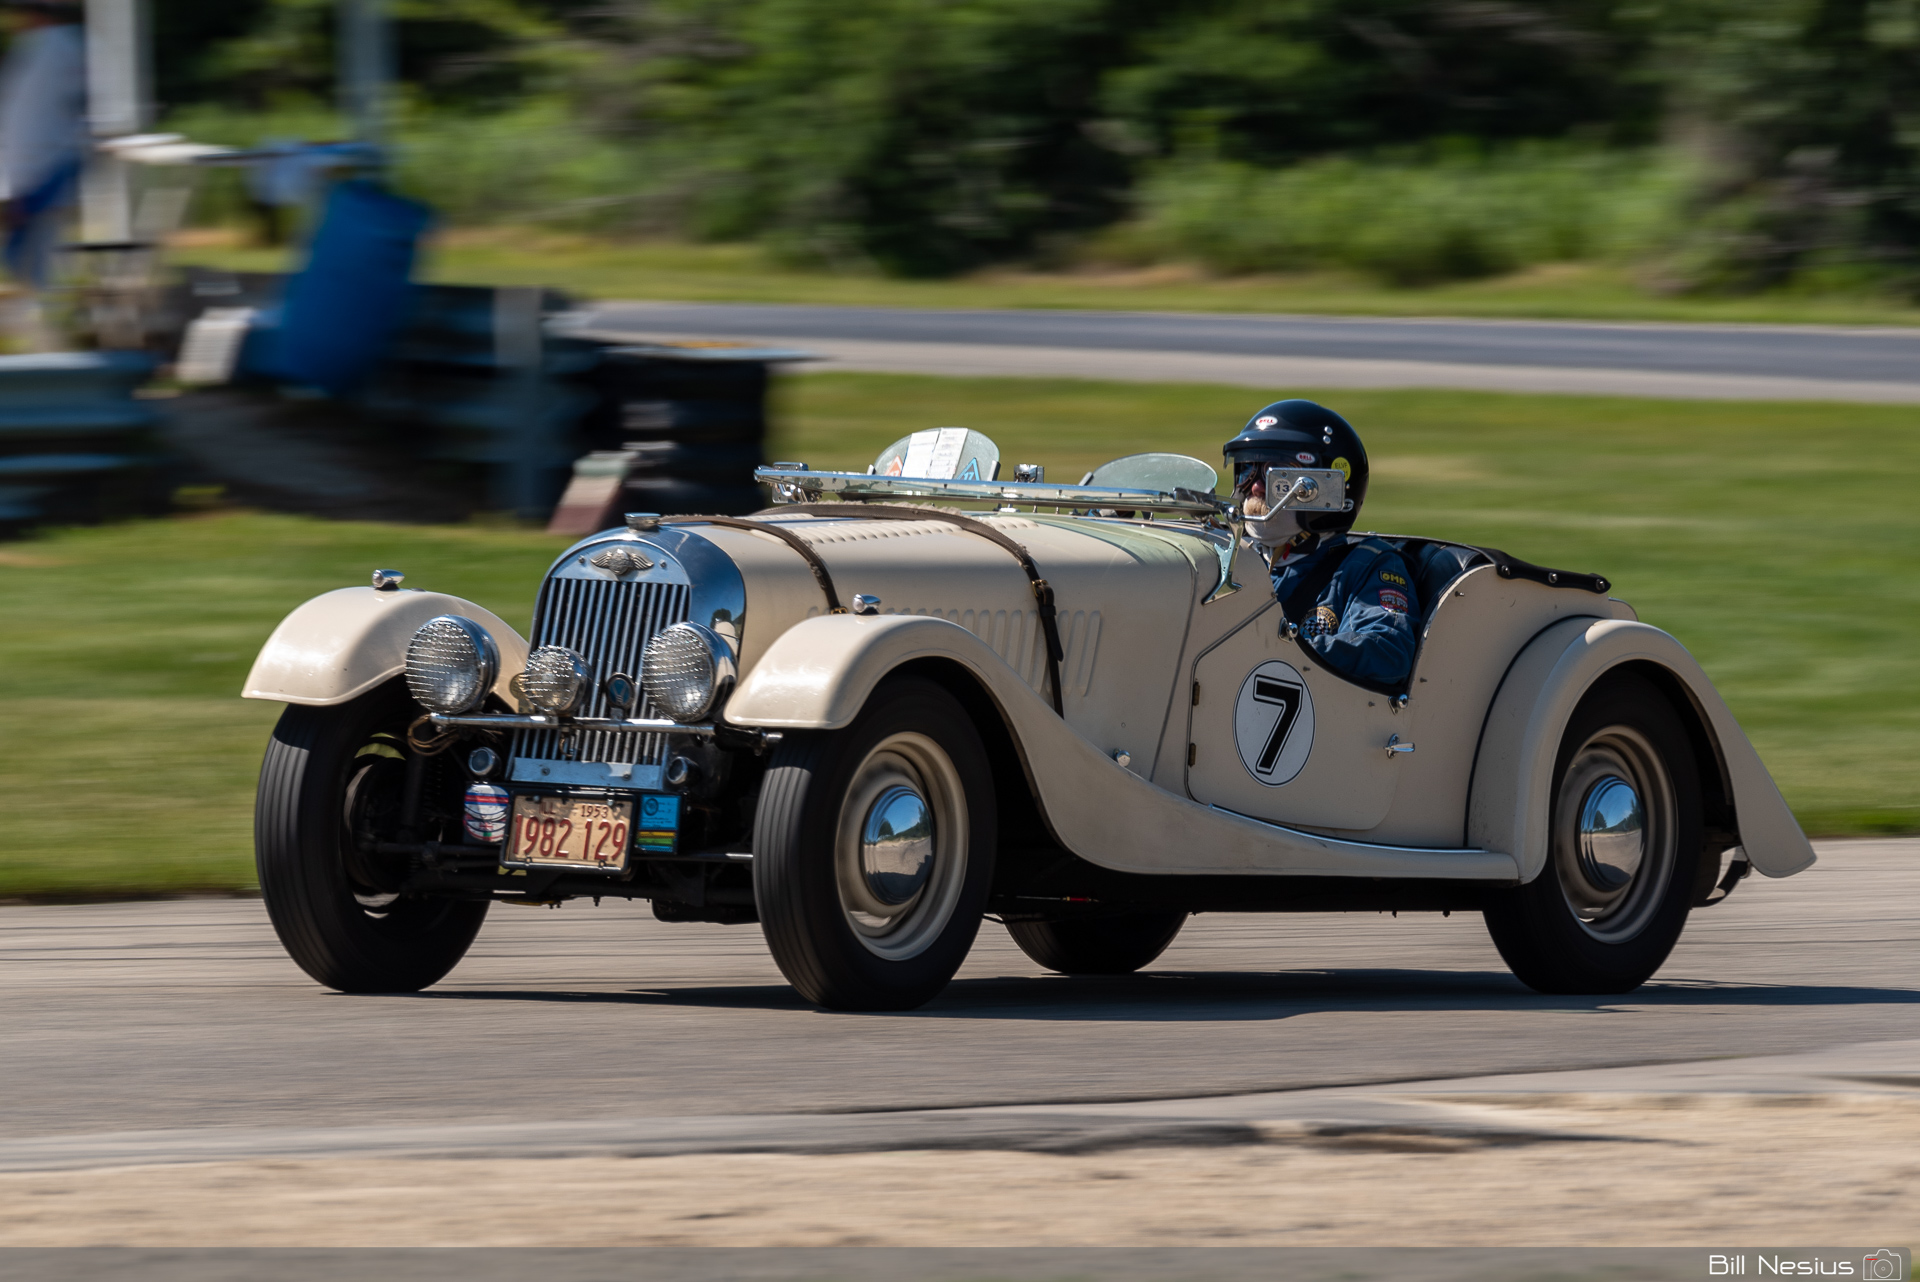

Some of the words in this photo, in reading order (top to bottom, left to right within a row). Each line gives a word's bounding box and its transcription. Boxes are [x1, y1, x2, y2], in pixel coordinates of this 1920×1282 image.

[1299, 453, 1313, 461] BELL
[1275, 484, 1290, 493] 13
[1382, 572, 1406, 585] OMP
[1253, 674, 1303, 775] 7
[581, 804, 609, 818] 1953
[513, 814, 574, 858] 1982
[583, 818, 627, 861] 129
